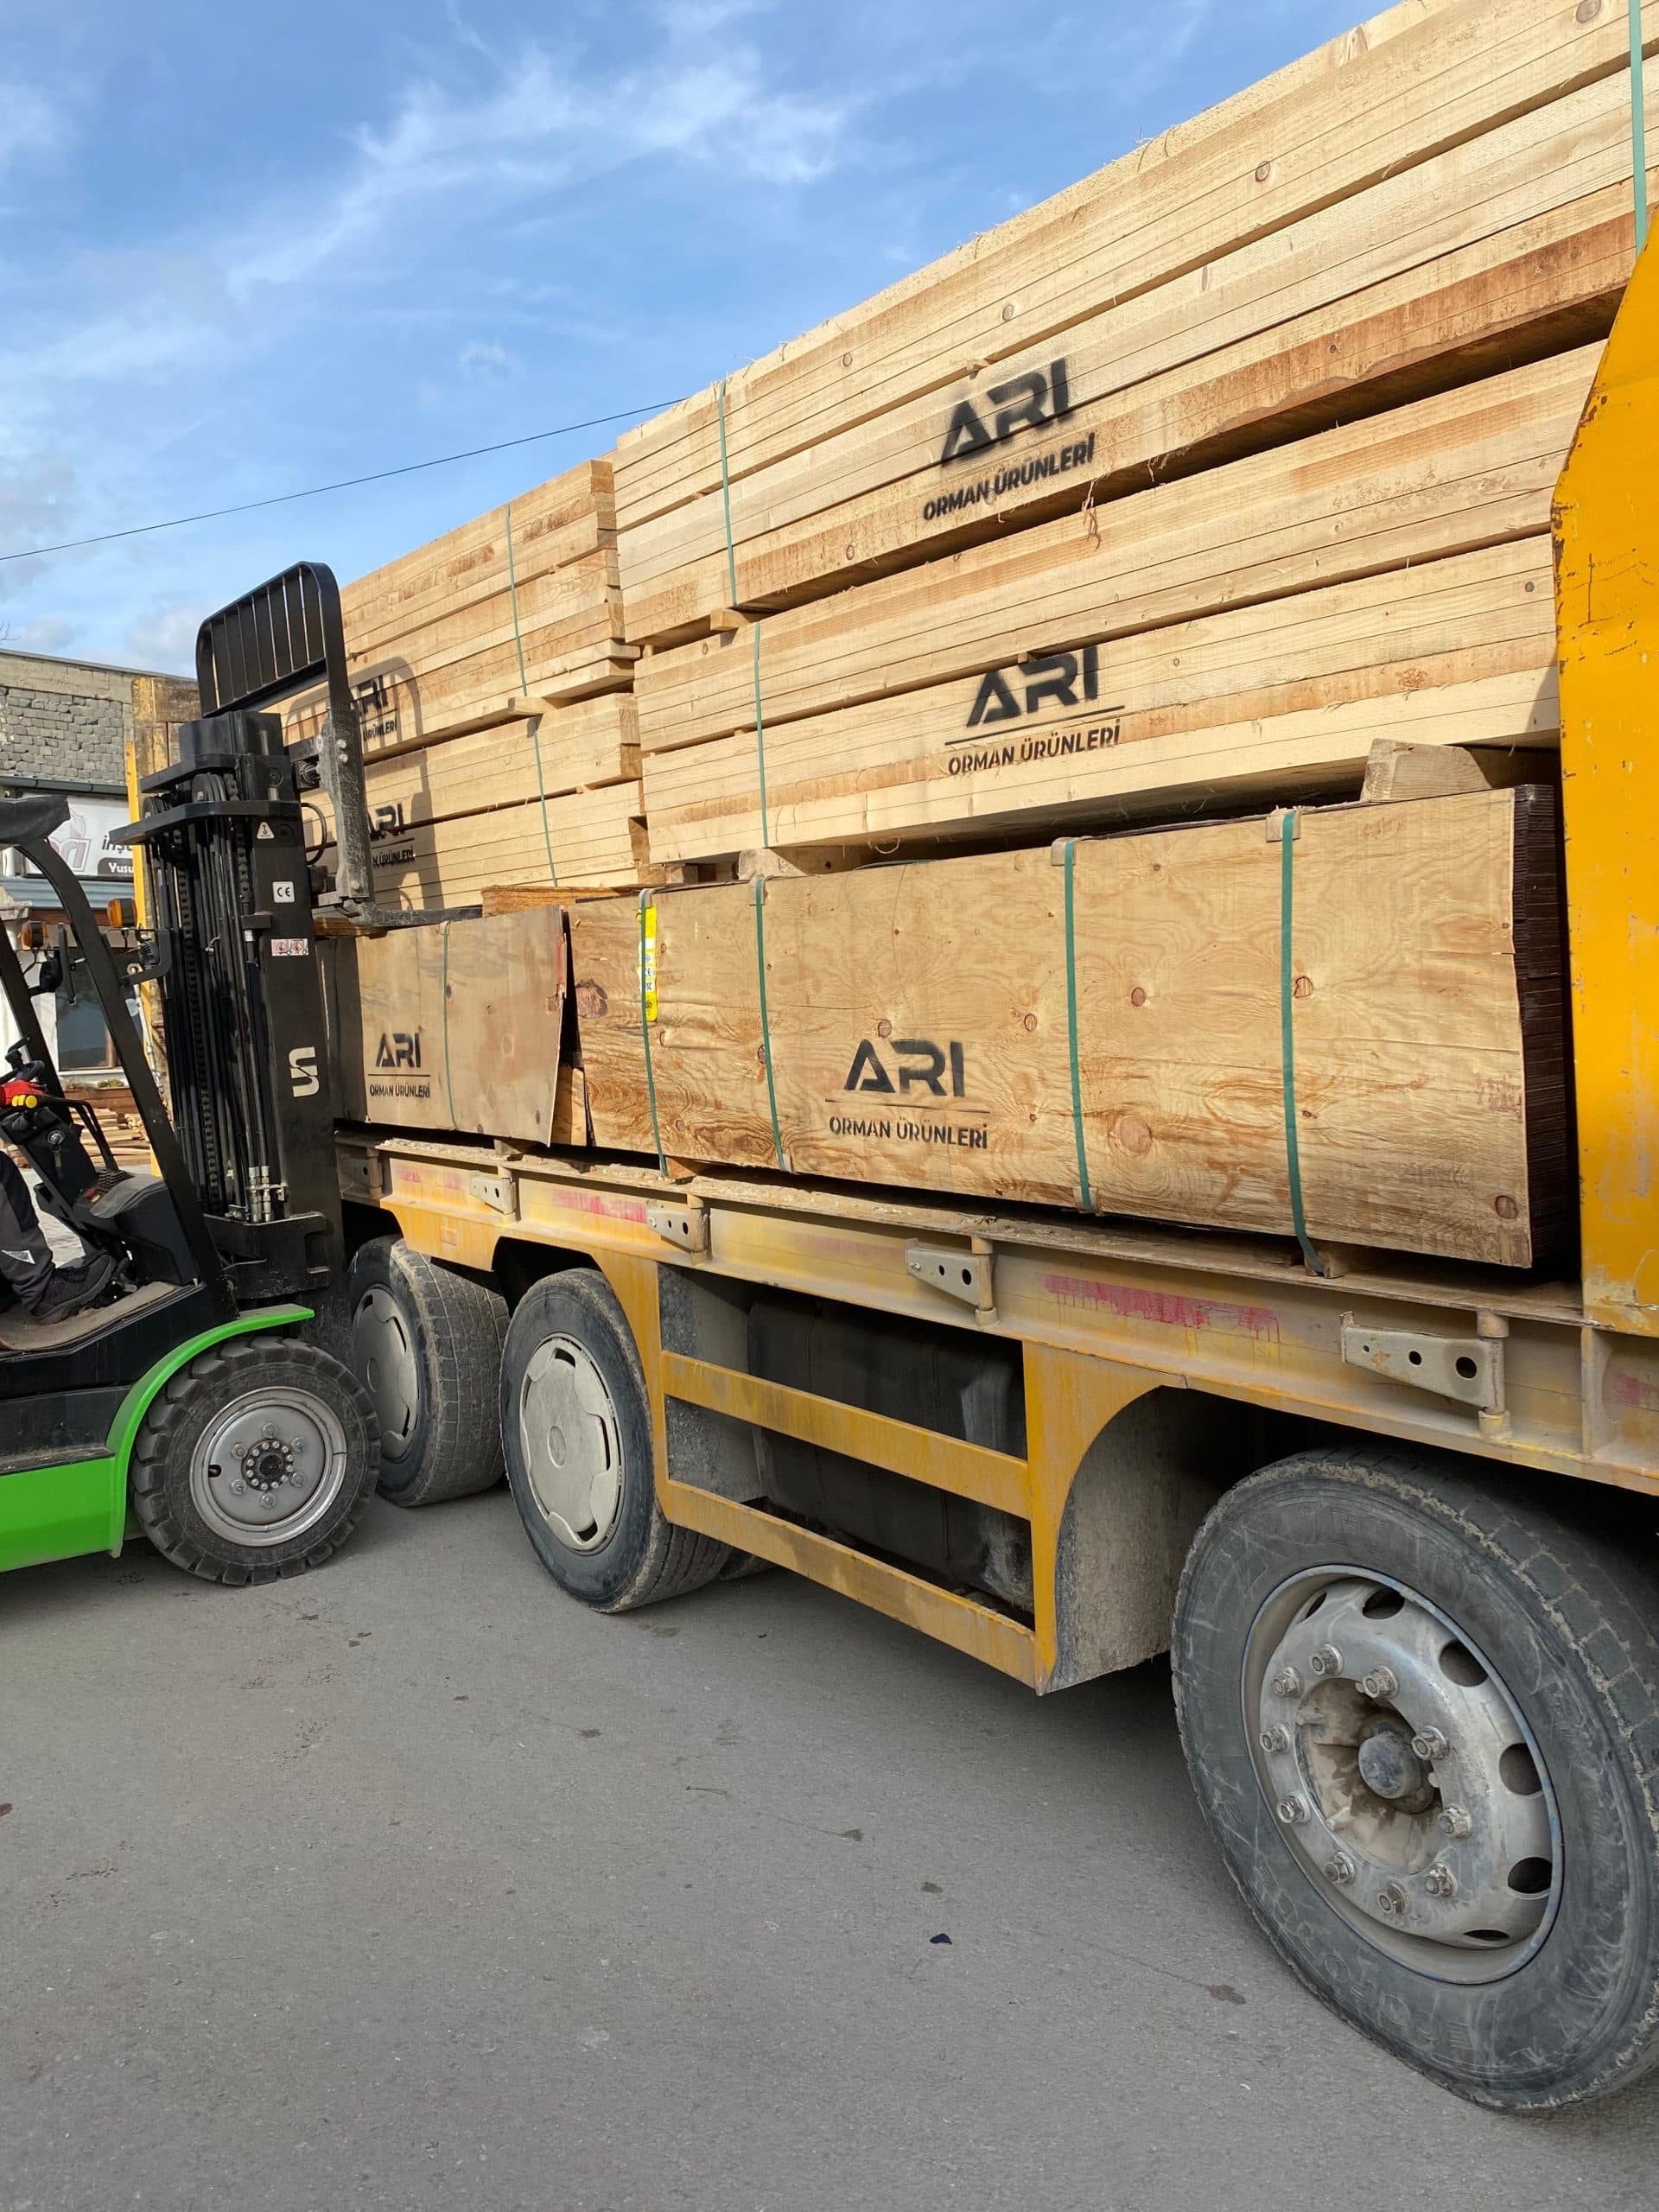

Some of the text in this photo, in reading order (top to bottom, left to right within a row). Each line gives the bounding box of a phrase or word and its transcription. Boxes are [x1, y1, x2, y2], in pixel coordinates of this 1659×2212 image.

[940, 358, 1074, 467] ARI
[922, 432, 1096, 521] ORMAN ÜRÜNLERİ
[354, 675, 388, 715] RI
[967, 645, 1098, 728] ARI
[948, 719, 1121, 776] ORMAN ÜRÜNLERİ
[276, 887, 291, 897] CE
[375, 1032, 421, 1068] ARI
[843, 1039, 966, 1097] ARI
[370, 1082, 430, 1098] ORMAN ÜRÜNLERİ
[830, 1116, 988, 1149] ORMAN ÜRÜNLERİ
